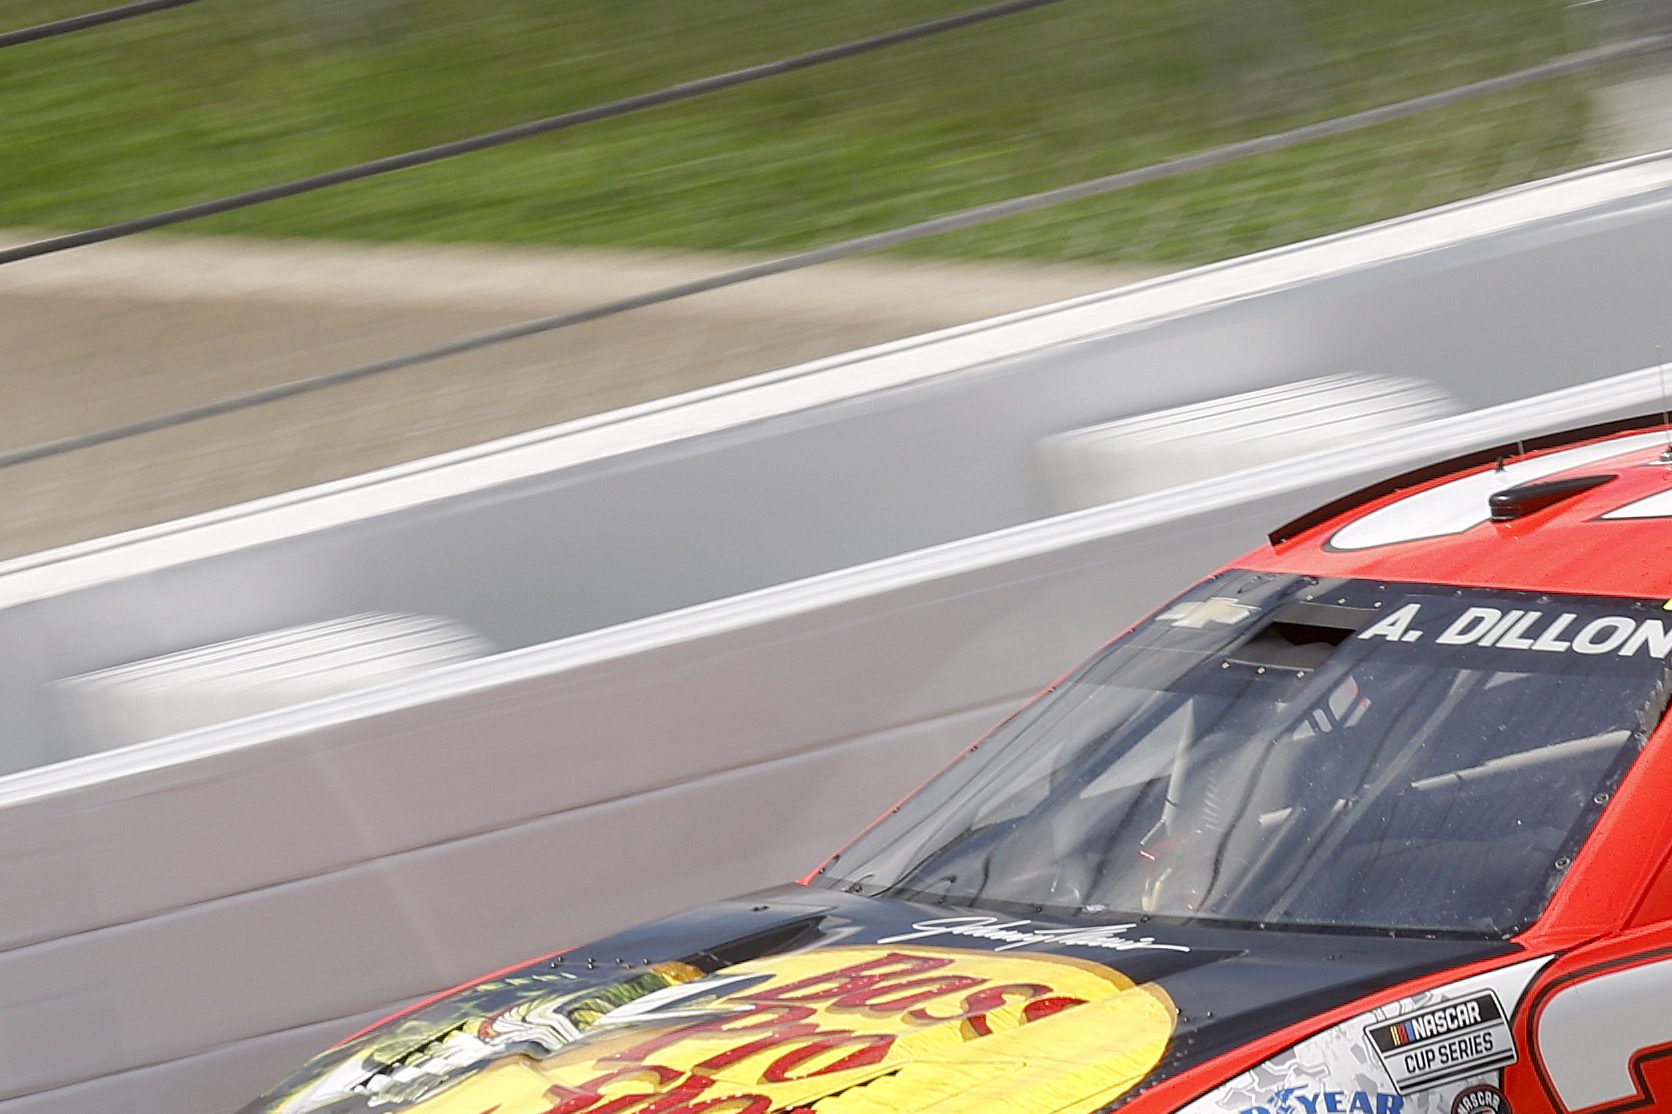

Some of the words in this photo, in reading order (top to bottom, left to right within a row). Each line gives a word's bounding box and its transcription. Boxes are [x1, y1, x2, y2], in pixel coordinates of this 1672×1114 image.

[1357, 603, 1422, 642] A.
[1410, 1001, 1481, 1040] NASCAR
[1404, 1051, 1436, 1074] CUP
[1439, 1032, 1494, 1064] SERIES
